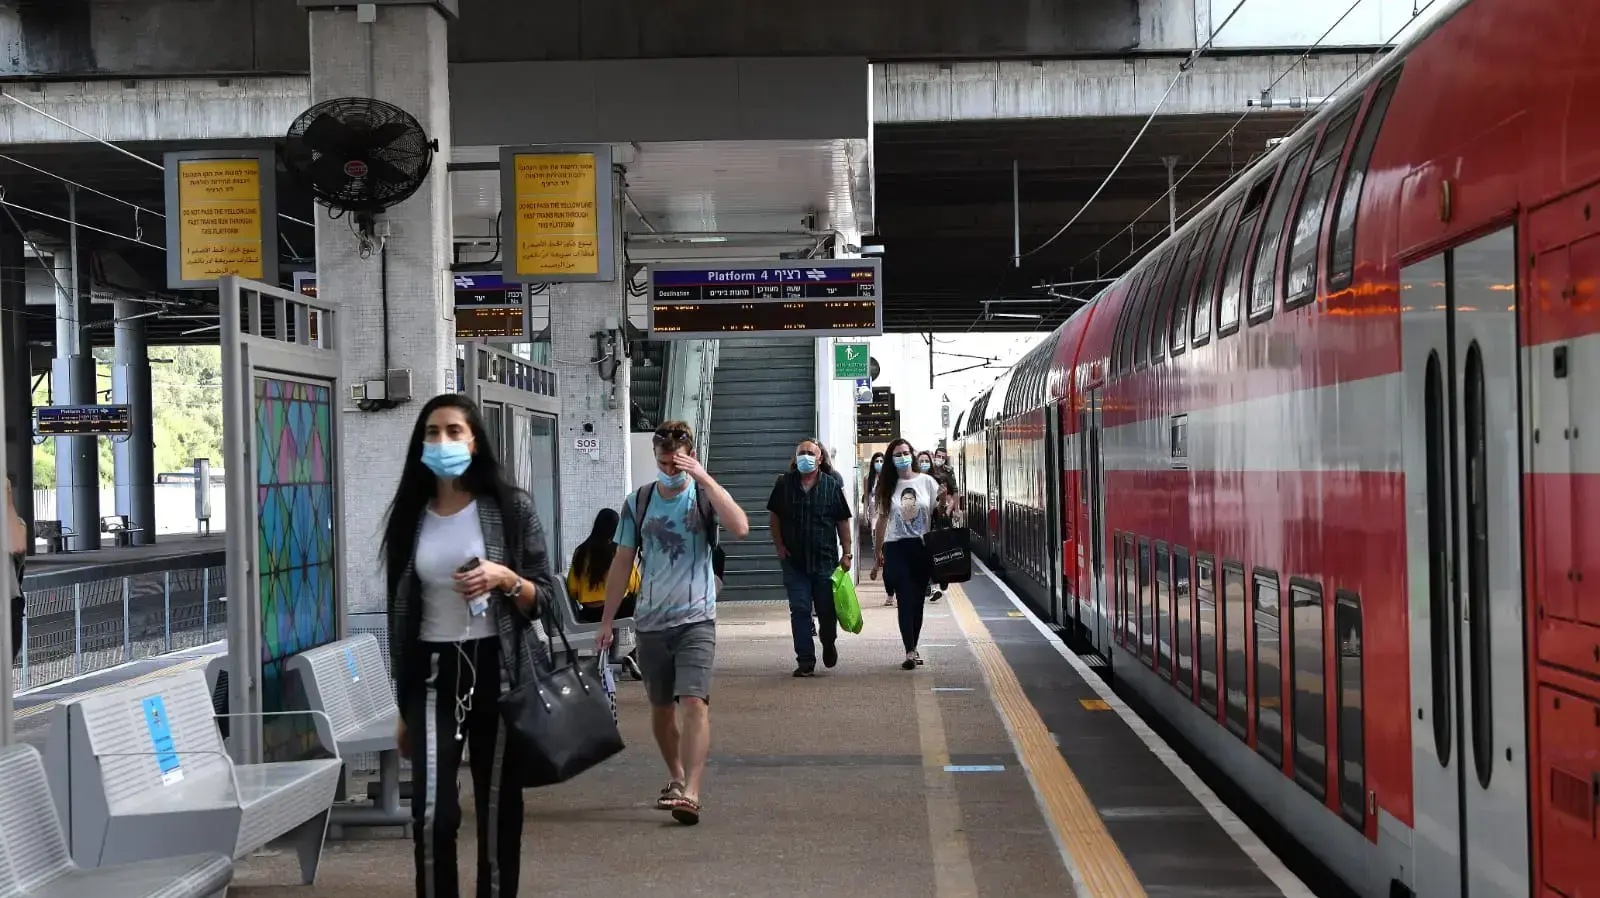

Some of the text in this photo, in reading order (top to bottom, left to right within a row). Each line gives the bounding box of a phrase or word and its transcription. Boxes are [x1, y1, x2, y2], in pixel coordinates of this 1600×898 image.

[708, 270, 800, 281] Platform 4 רציף
